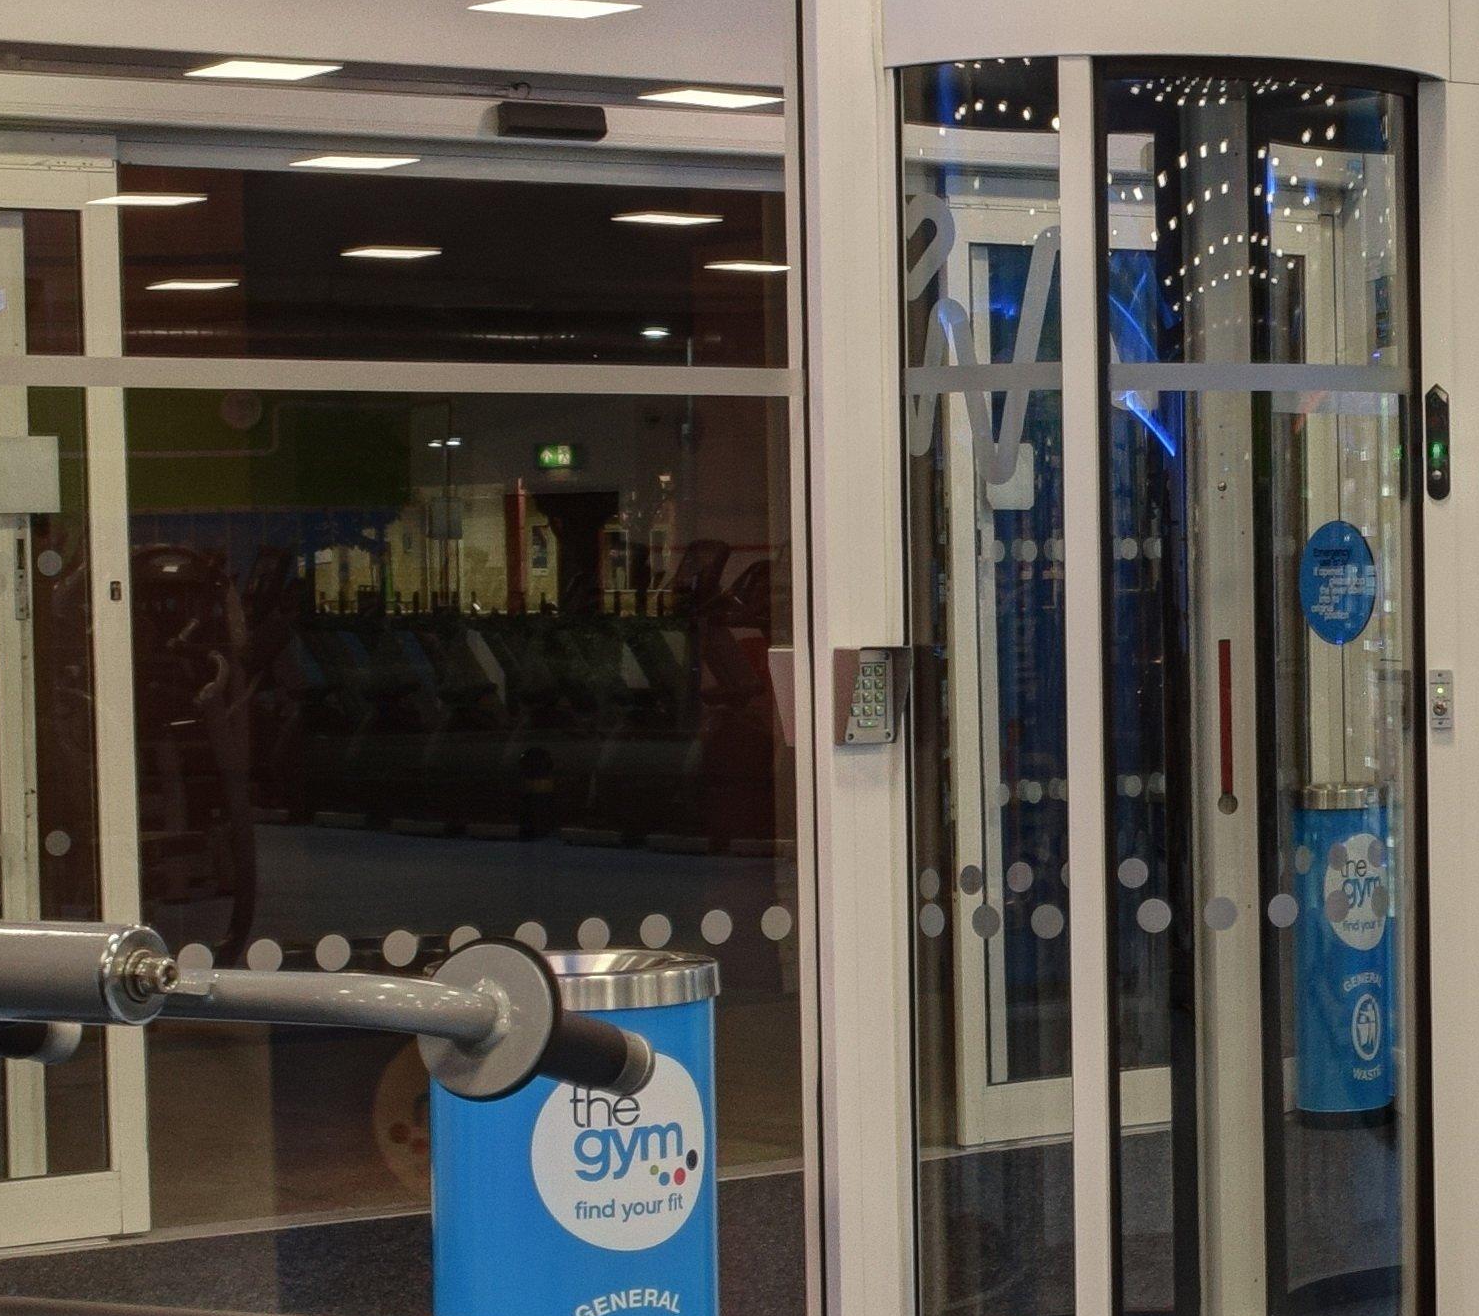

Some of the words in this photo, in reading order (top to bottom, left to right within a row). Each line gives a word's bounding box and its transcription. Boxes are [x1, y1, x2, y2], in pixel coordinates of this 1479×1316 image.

[570, 1085, 641, 1129] the
[573, 1121, 684, 1183] gym
[575, 1198, 615, 1220] find
[621, 1198, 663, 1223] your
[668, 1191, 684, 1211] fit
